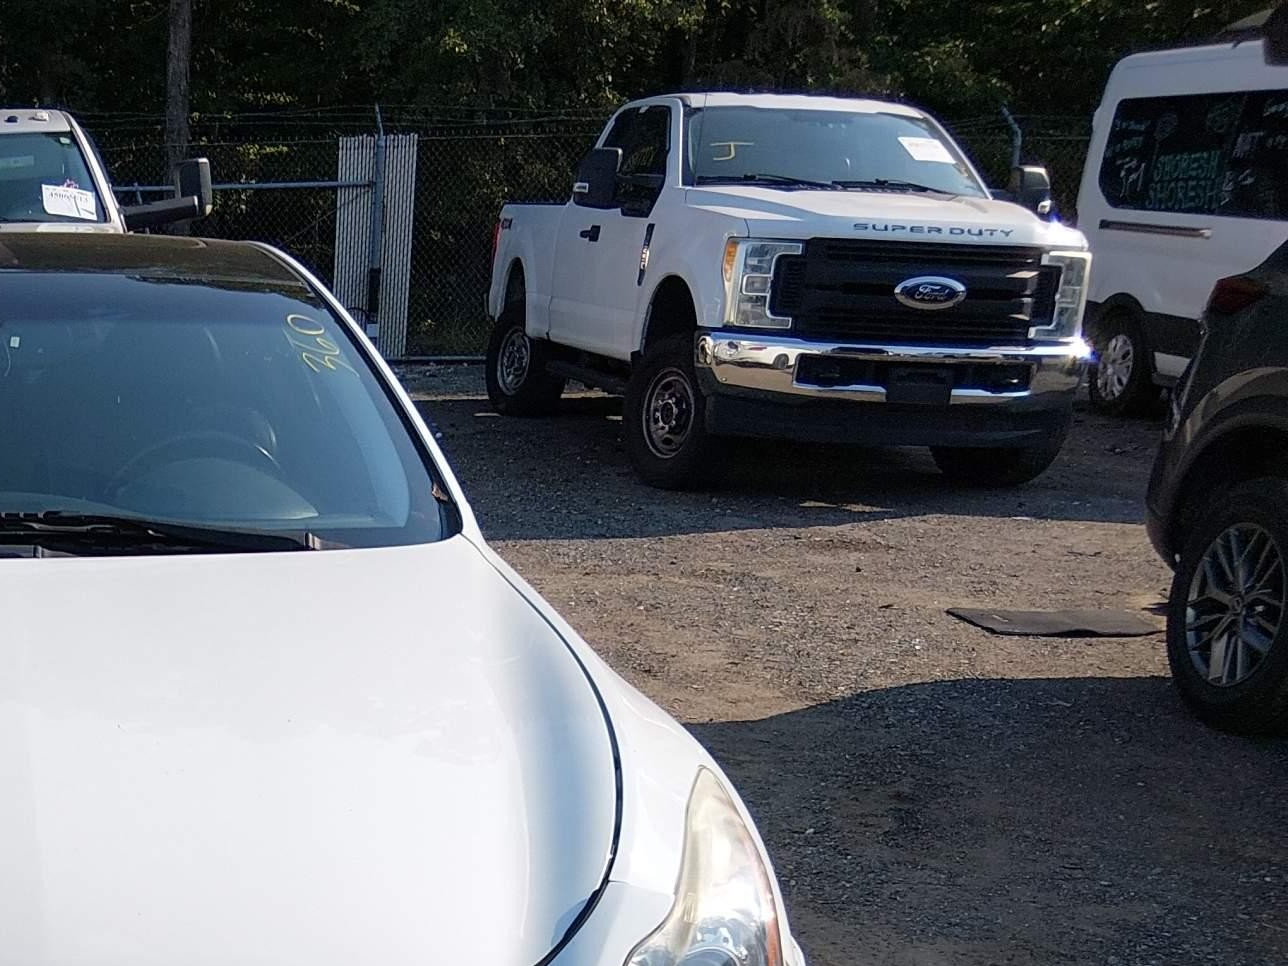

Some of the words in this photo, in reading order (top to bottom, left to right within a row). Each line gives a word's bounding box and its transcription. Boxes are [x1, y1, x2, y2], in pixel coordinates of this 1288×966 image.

[709, 141, 755, 161] J
[853, 223, 944, 235] SUPER
[949, 227, 1014, 238] DUTY
[914, 284, 950, 300] Ford
